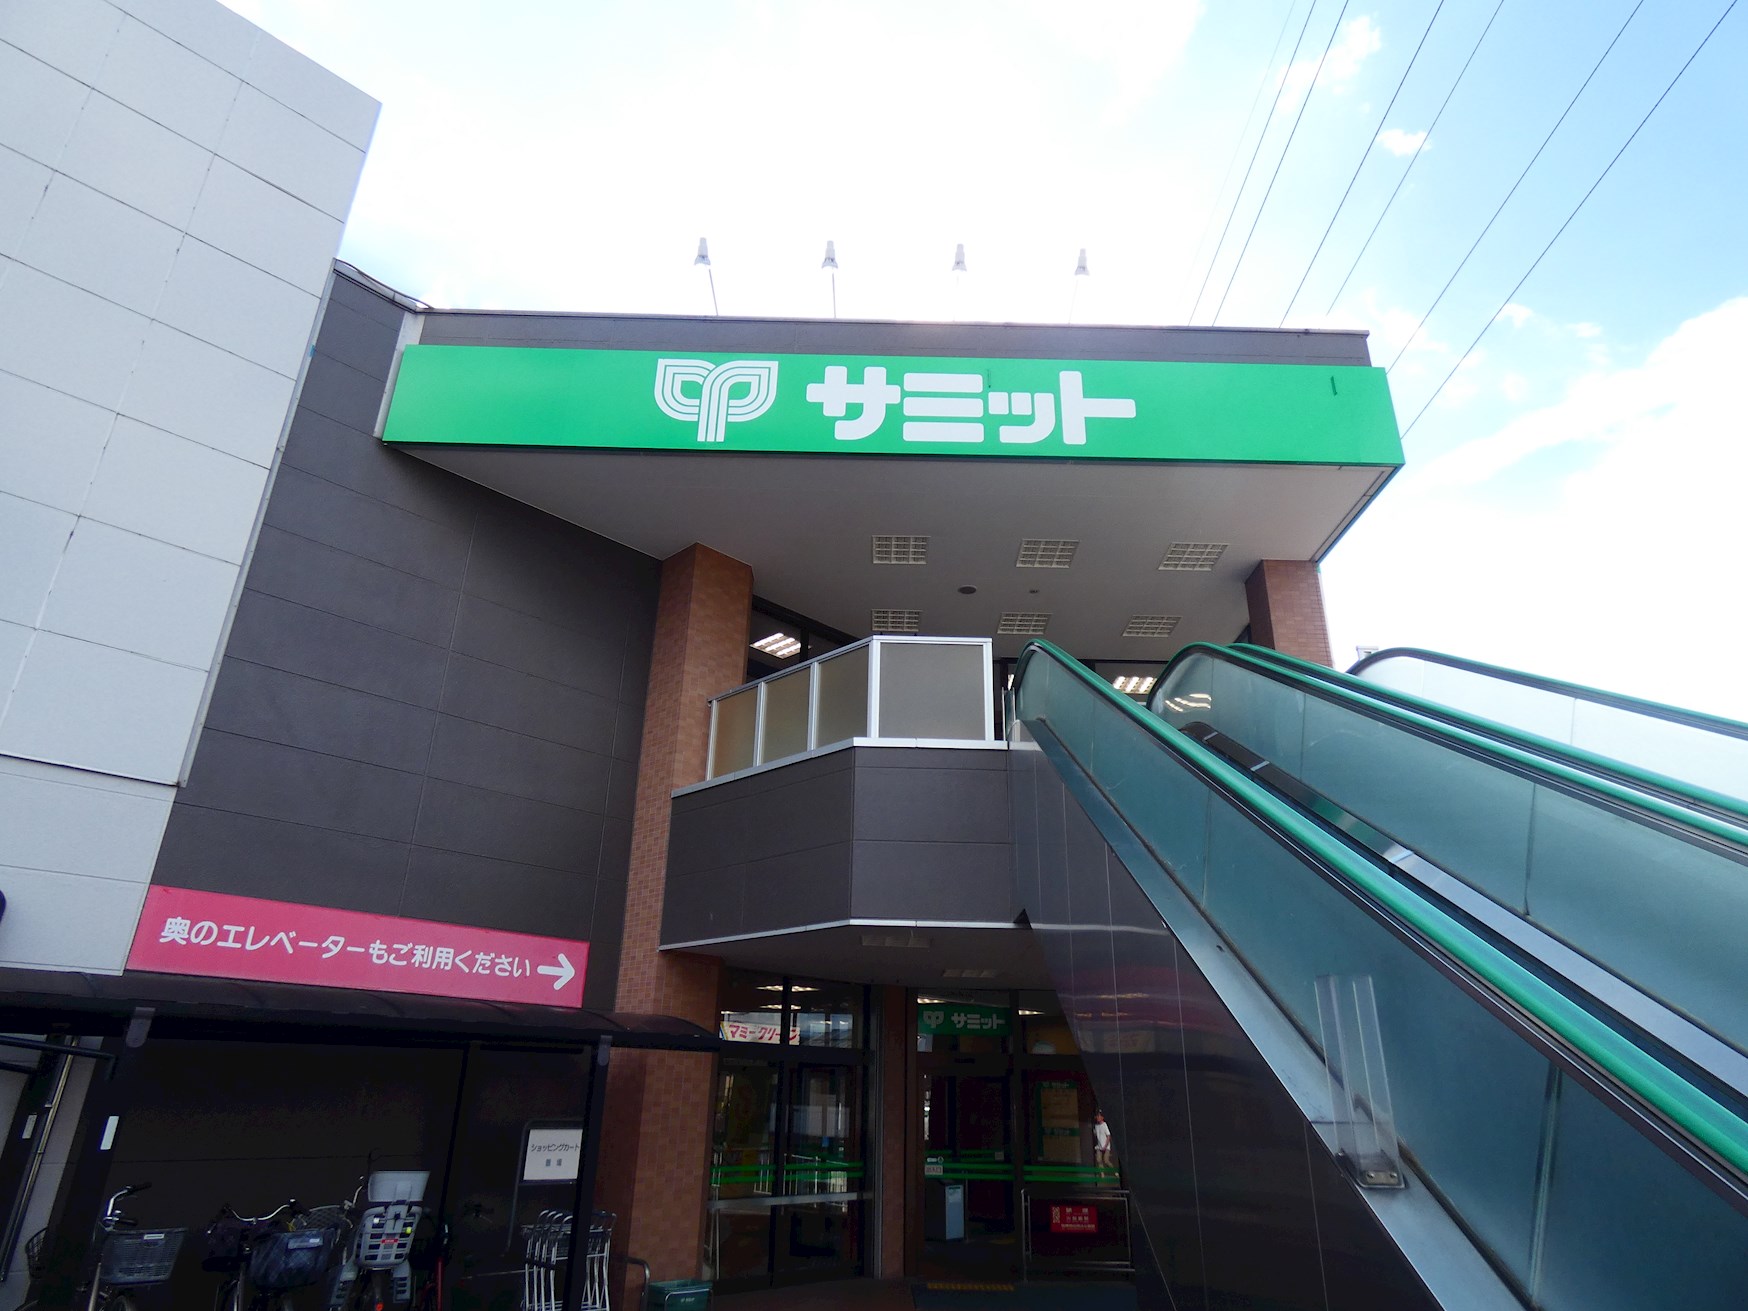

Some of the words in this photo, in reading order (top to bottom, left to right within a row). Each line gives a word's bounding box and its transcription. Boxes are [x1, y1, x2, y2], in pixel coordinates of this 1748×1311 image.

[806, 366, 1136, 445] サミット
[159, 916, 530, 978] 奥のエレベーターもご利用ください
[951, 1013, 1006, 1029] サミット
[531, 1143, 580, 1152] ショッピングカート
